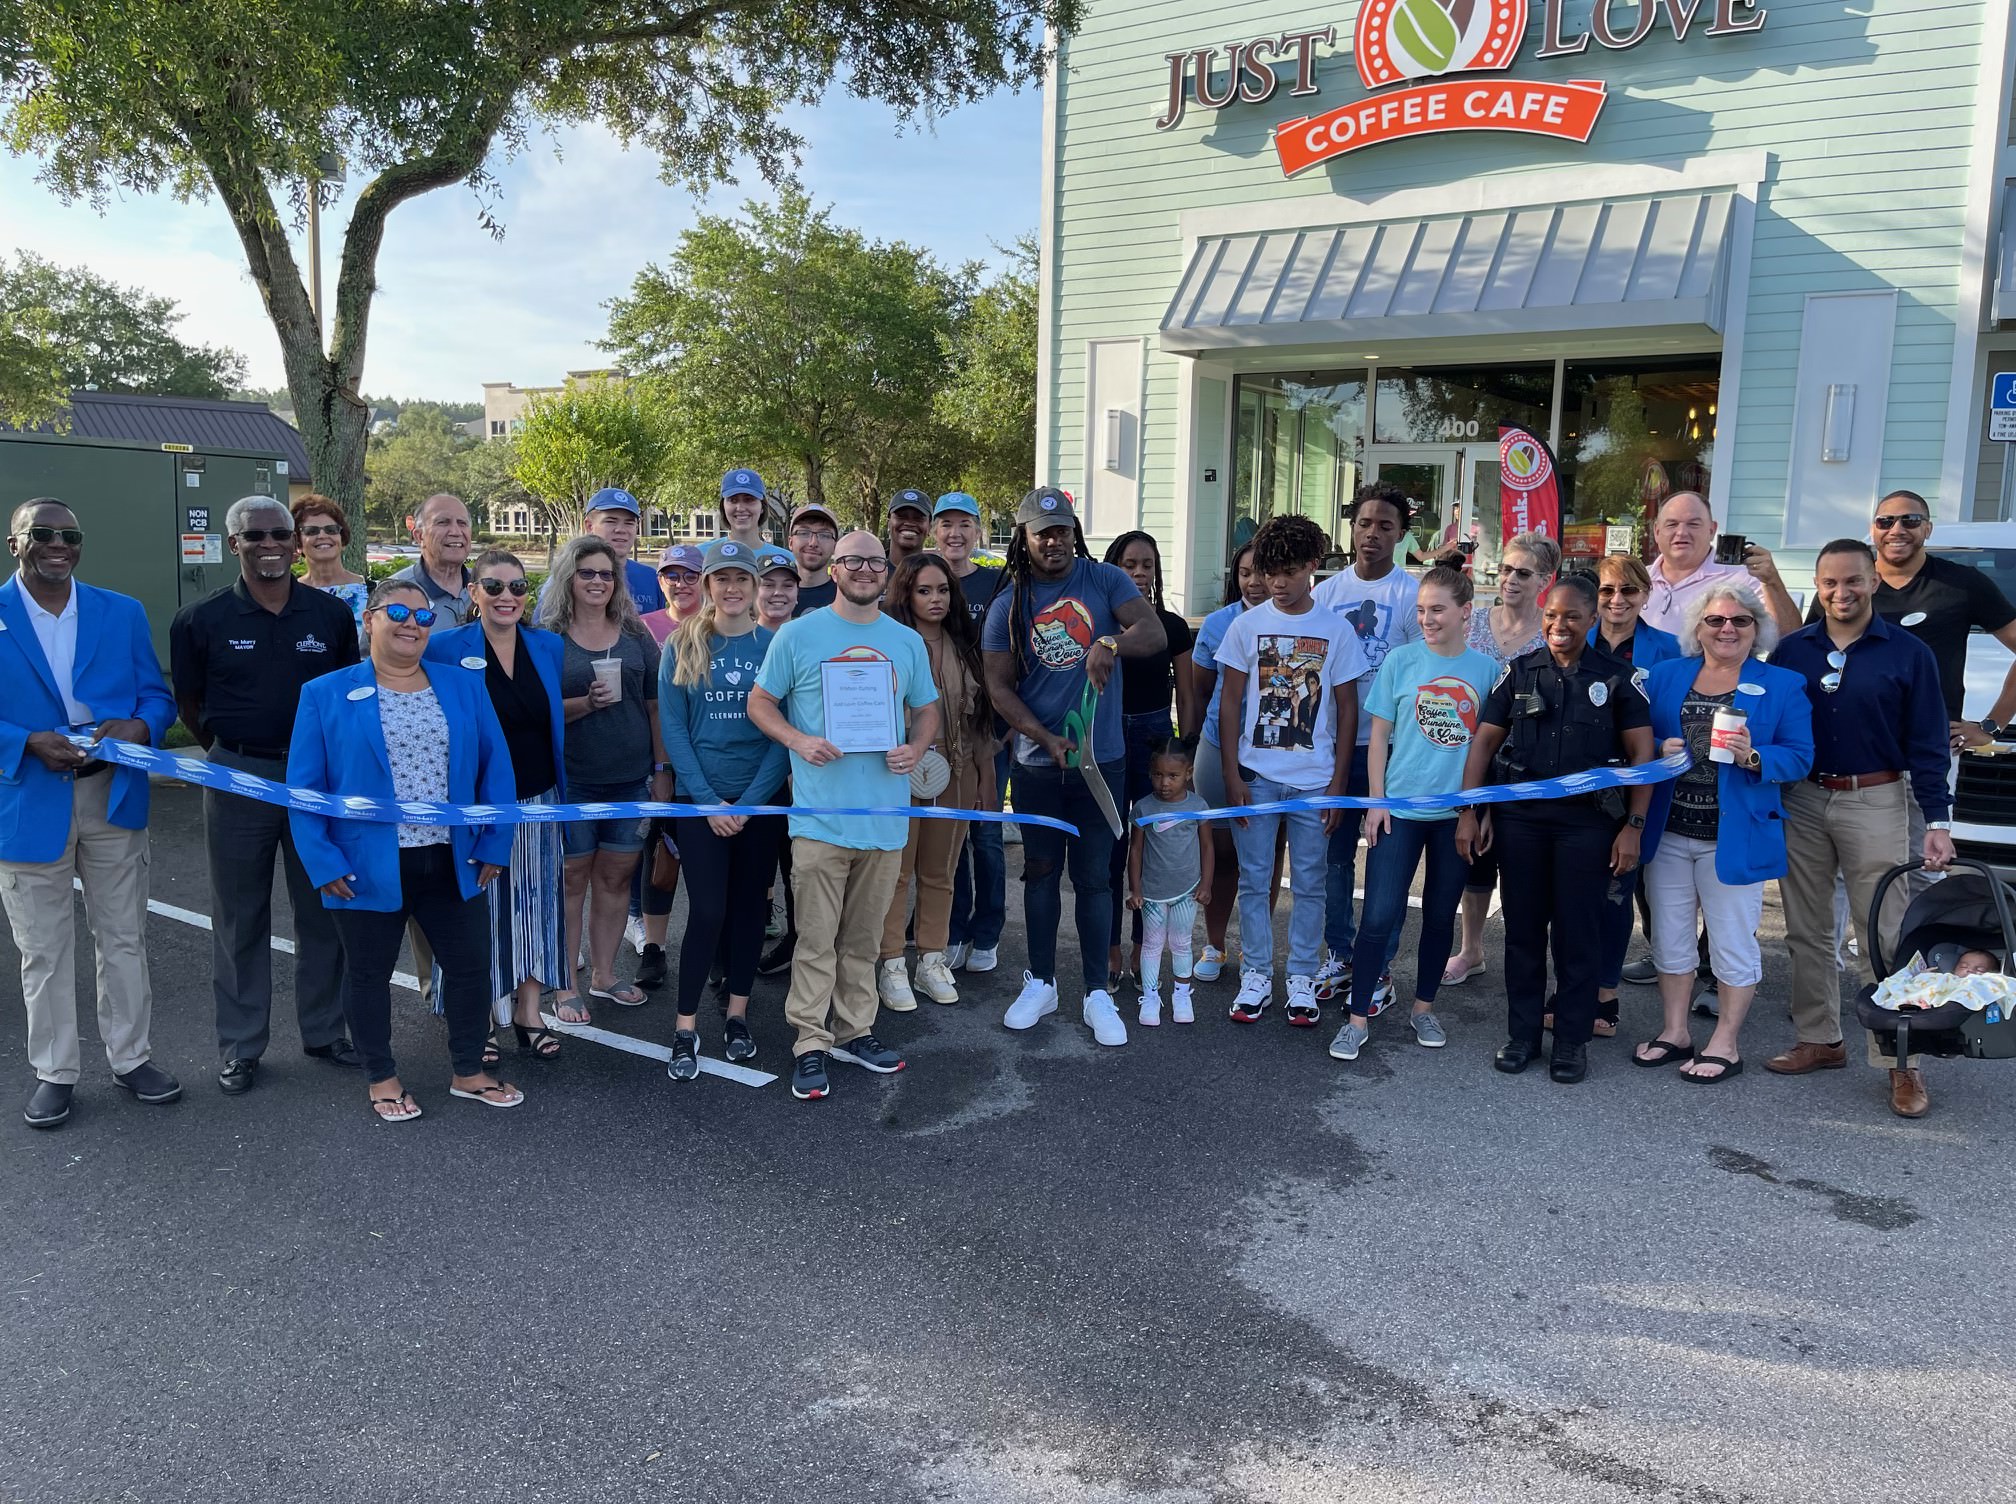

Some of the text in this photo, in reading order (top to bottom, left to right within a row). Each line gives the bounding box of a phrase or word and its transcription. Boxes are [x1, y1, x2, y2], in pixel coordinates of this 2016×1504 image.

[1156, 0, 1768, 130] JUST LOVE
[1305, 90, 1569, 152] COFFEE CAFE
[1439, 420, 1479, 437] 400
[189, 510, 208, 518] NON
[1512, 492, 1528, 536] ink.
[190, 519, 208, 527] PCB
[1054, 647, 1081, 663] Love
[1428, 728, 1467, 744] & Love
